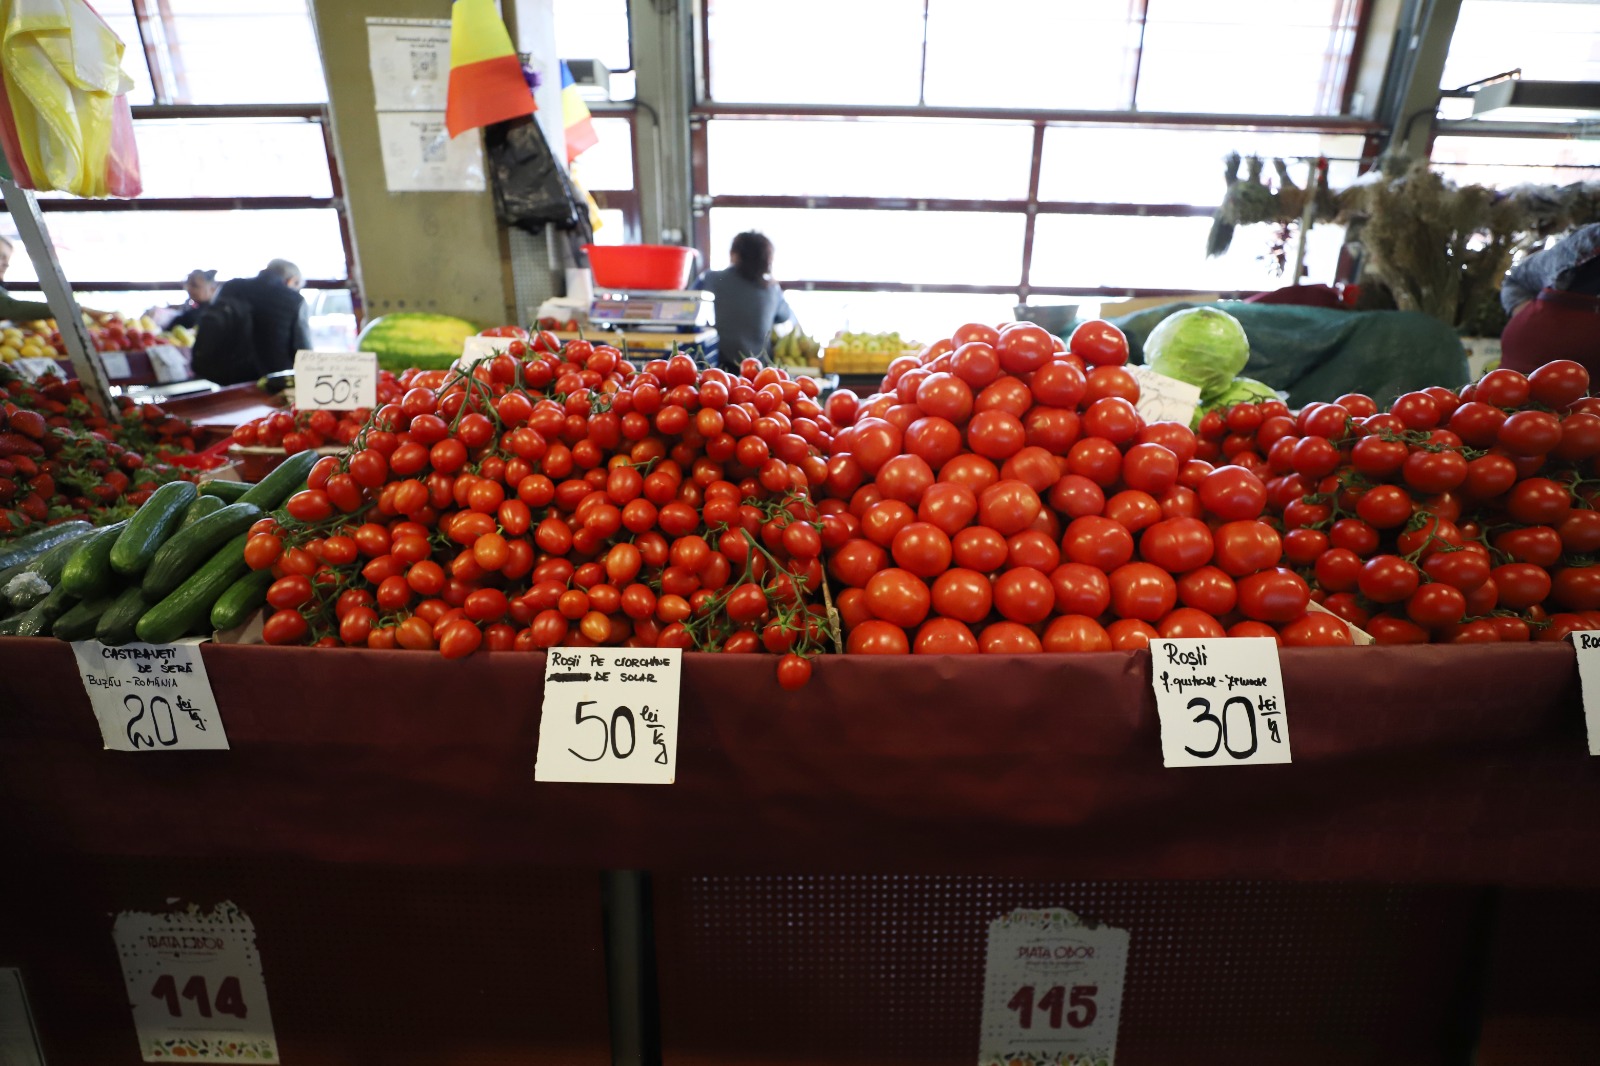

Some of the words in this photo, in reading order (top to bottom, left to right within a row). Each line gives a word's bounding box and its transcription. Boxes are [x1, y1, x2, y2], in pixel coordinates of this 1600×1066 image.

[313, 375, 350, 405] 50
[138, 663, 152, 673] DE
[590, 654, 605, 666] PE
[594, 672, 611, 681] DE
[620, 673, 657, 683] SOLAR
[124, 694, 178, 749] 20
[640, 705, 658, 722] lei
[1185, 696, 1258, 759] 30
[568, 701, 636, 761] 50
[1055, 946, 1095, 959] OBOR
[151, 974, 247, 1019] 114
[1007, 985, 1098, 1029] 115
